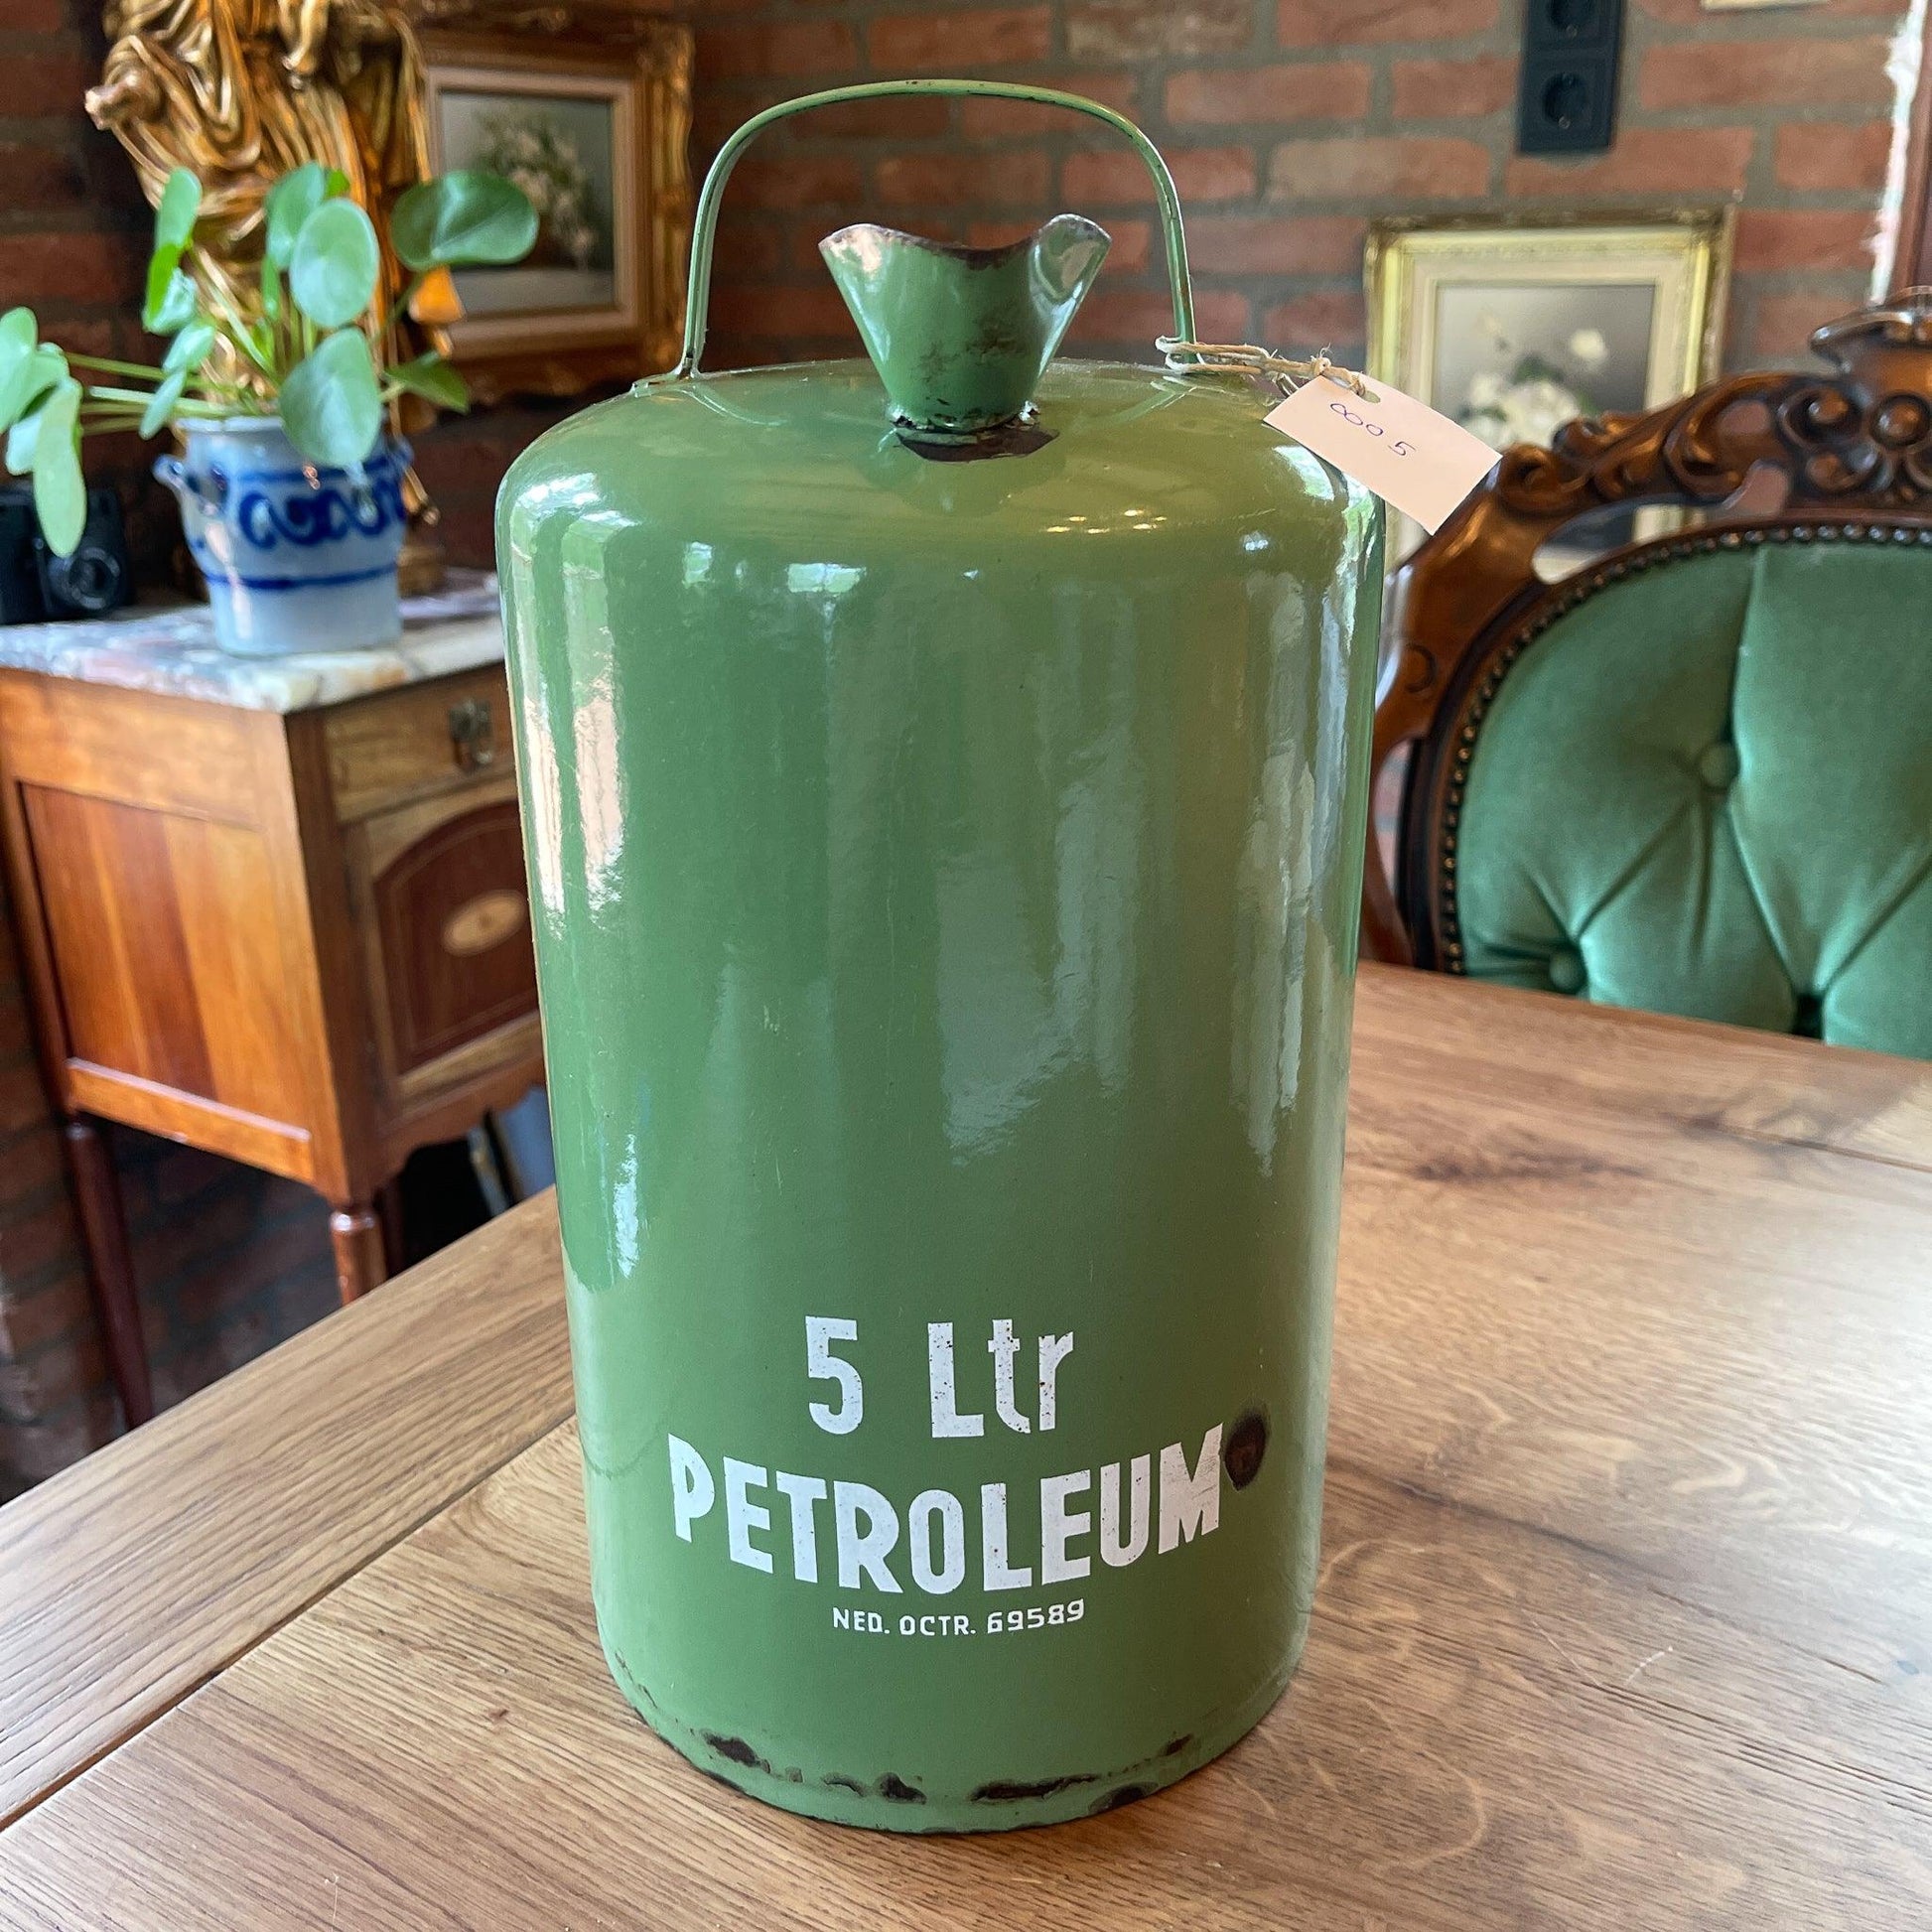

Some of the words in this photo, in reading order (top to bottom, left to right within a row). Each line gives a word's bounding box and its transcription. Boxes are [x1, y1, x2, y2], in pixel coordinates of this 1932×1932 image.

[804, 1315, 864, 1435] 5
[927, 1318, 1074, 1439] Ltr
[667, 1423, 1223, 1594] PETROLEUM
[832, 1606, 891, 1635] NED.
[898, 1614, 977, 1637] OCTR.
[987, 1598, 1084, 1635] 69589
